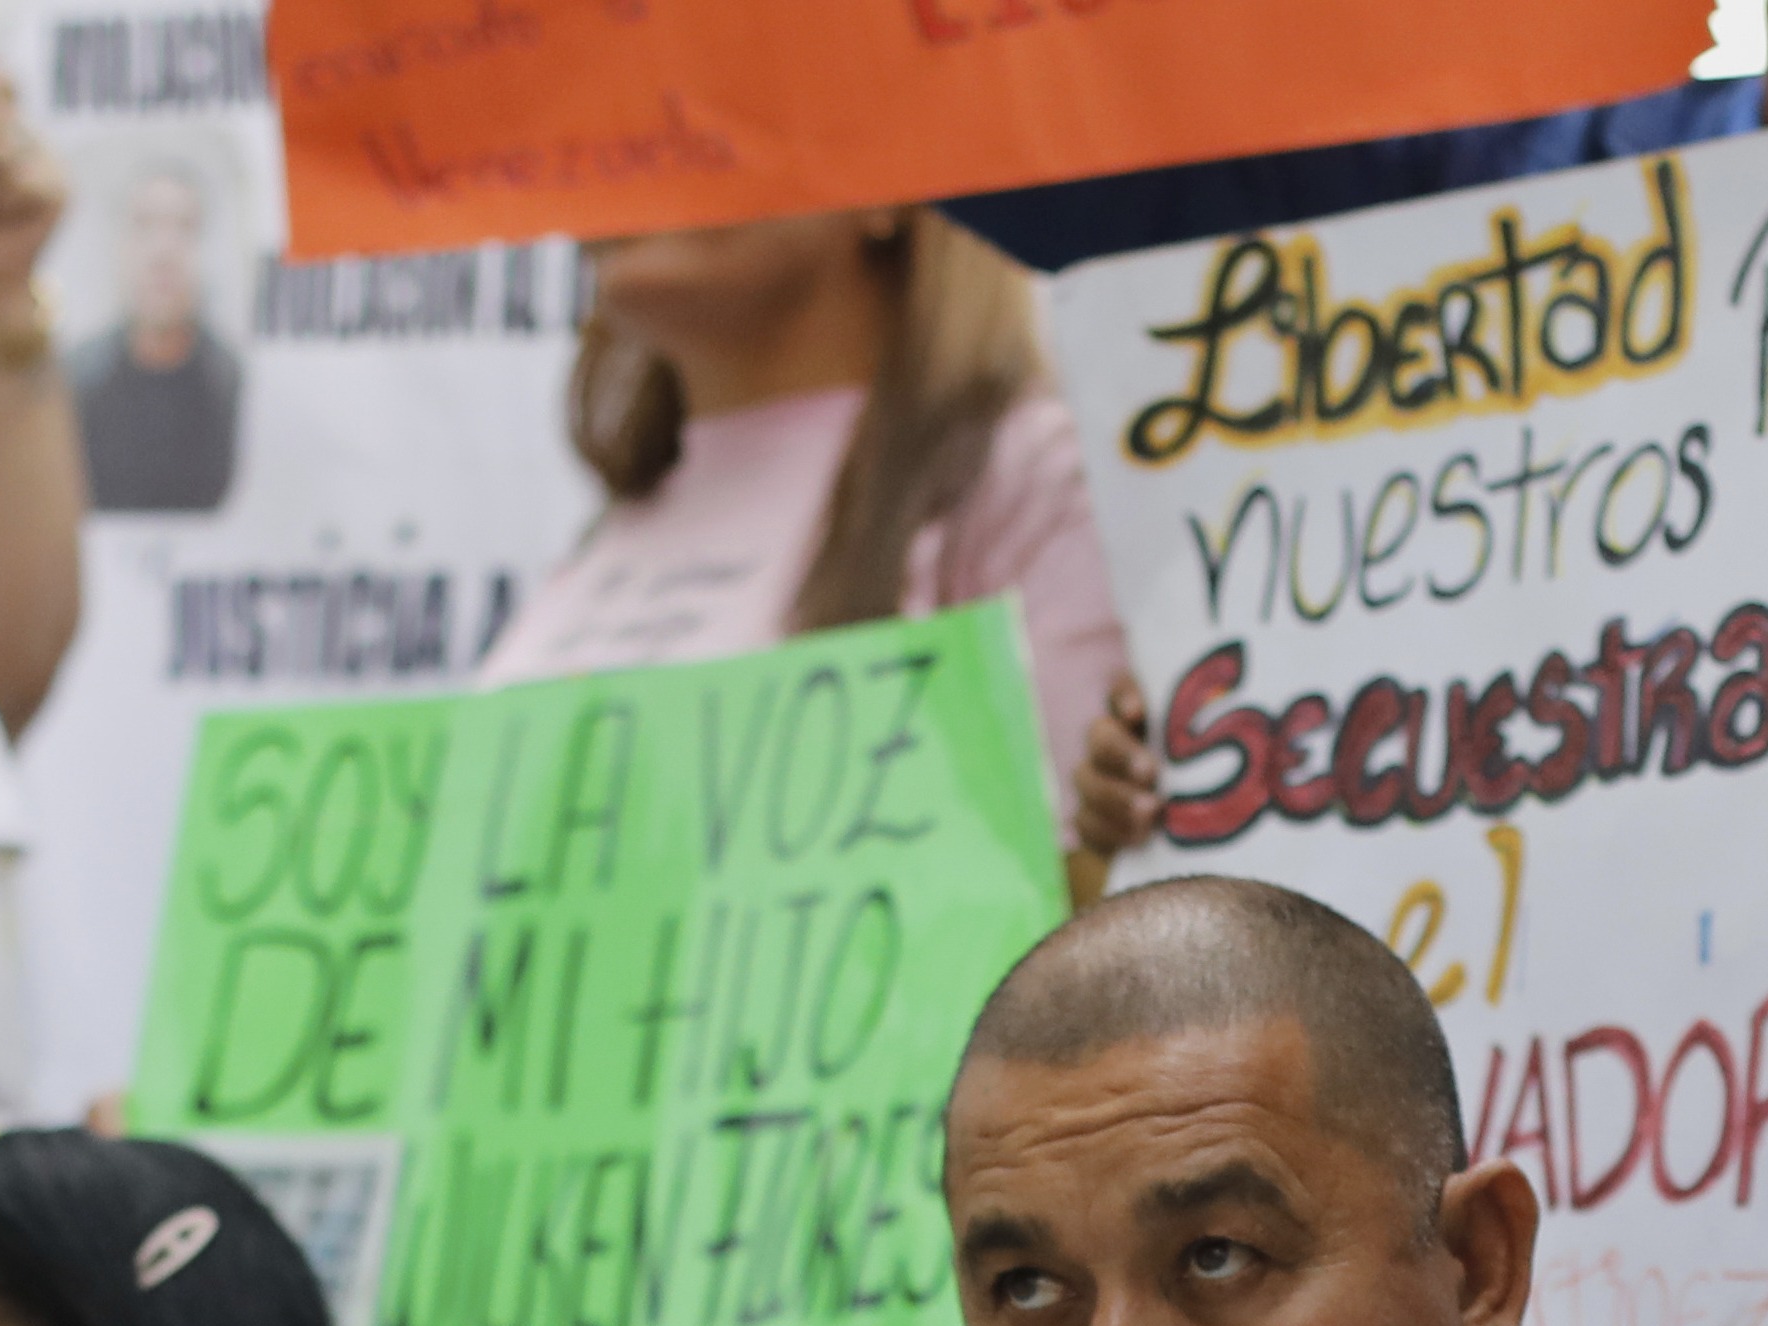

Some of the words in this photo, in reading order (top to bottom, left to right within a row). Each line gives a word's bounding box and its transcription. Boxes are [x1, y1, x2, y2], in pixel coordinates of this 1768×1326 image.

[1184, 421, 1714, 624] nuestros
[200, 720, 447, 922] SOY
[479, 695, 642, 905] LA
[694, 653, 941, 871] VOZ
[192, 928, 408, 1125] DE
[432, 914, 594, 1114] MI
[622, 888, 903, 1110] HIJO
